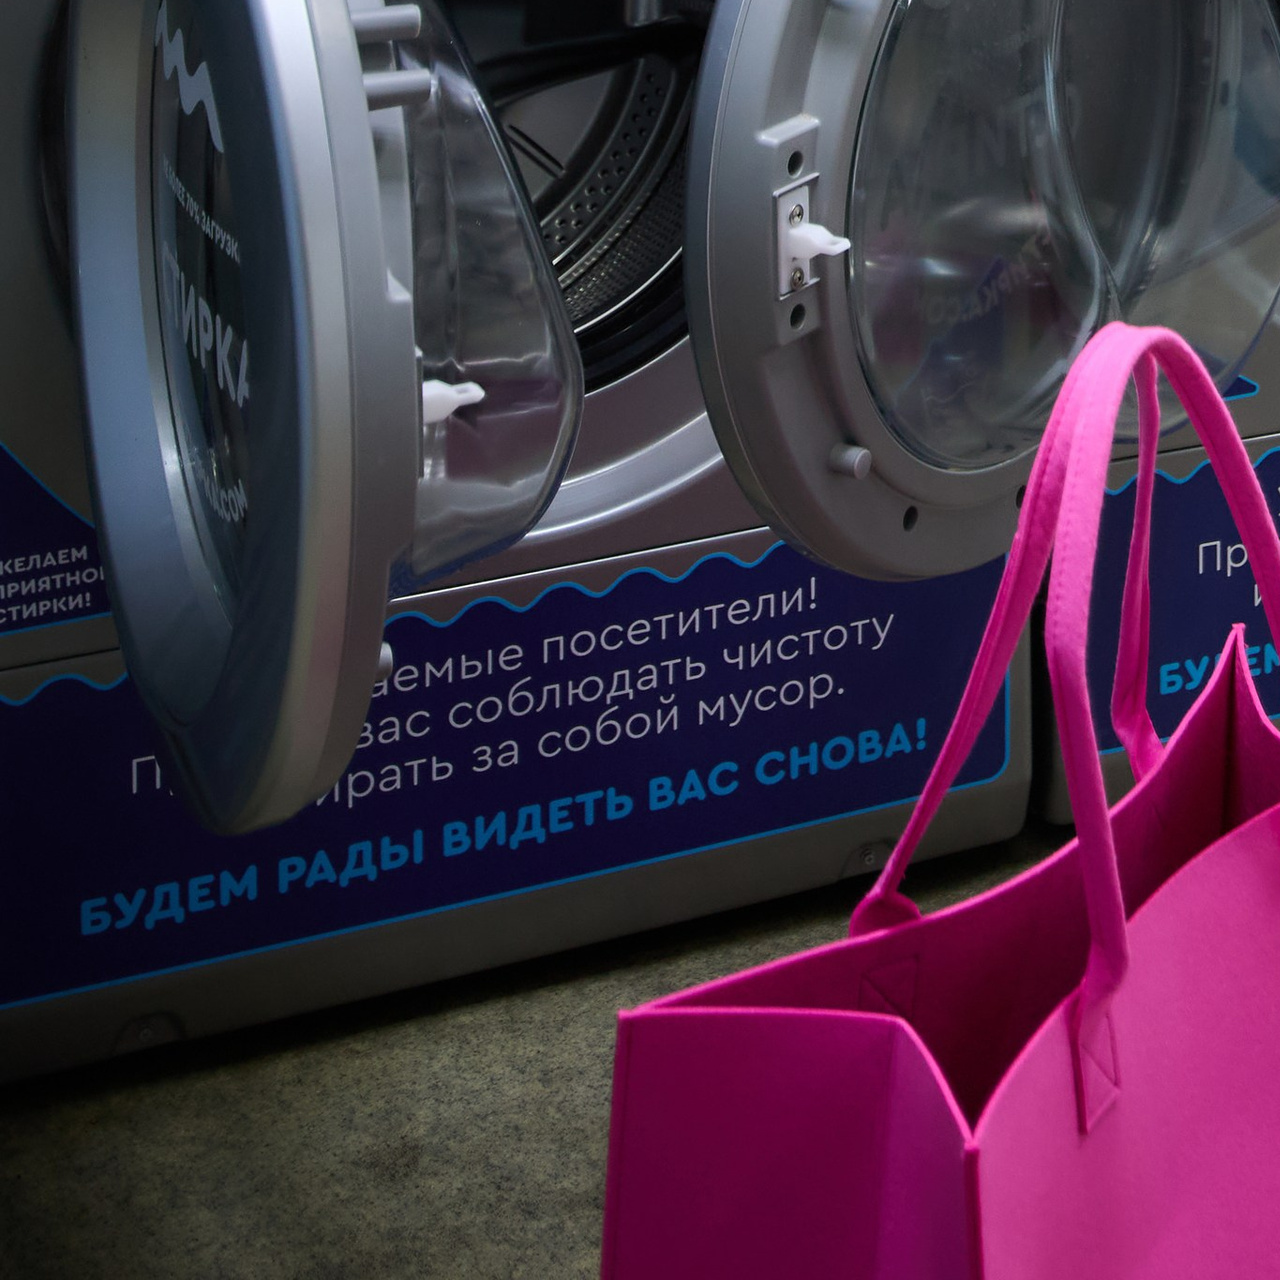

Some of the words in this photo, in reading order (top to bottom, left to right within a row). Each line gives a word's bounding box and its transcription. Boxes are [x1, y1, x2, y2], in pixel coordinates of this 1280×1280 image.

[449, 657, 705, 728] соблюдать
[724, 614, 894, 670] чистоту
[544, 577, 816, 663] посетители!
[473, 741, 518, 772] за
[538, 706, 677, 757] собой
[699, 674, 844, 726] мусор.
[81, 865, 257, 934] БУДЕМ
[279, 829, 423, 893] РАДЫ
[444, 787, 633, 856] ВИДЕТЬ
[649, 762, 738, 810] ВАС
[755, 718, 926, 785] СНОВА!
